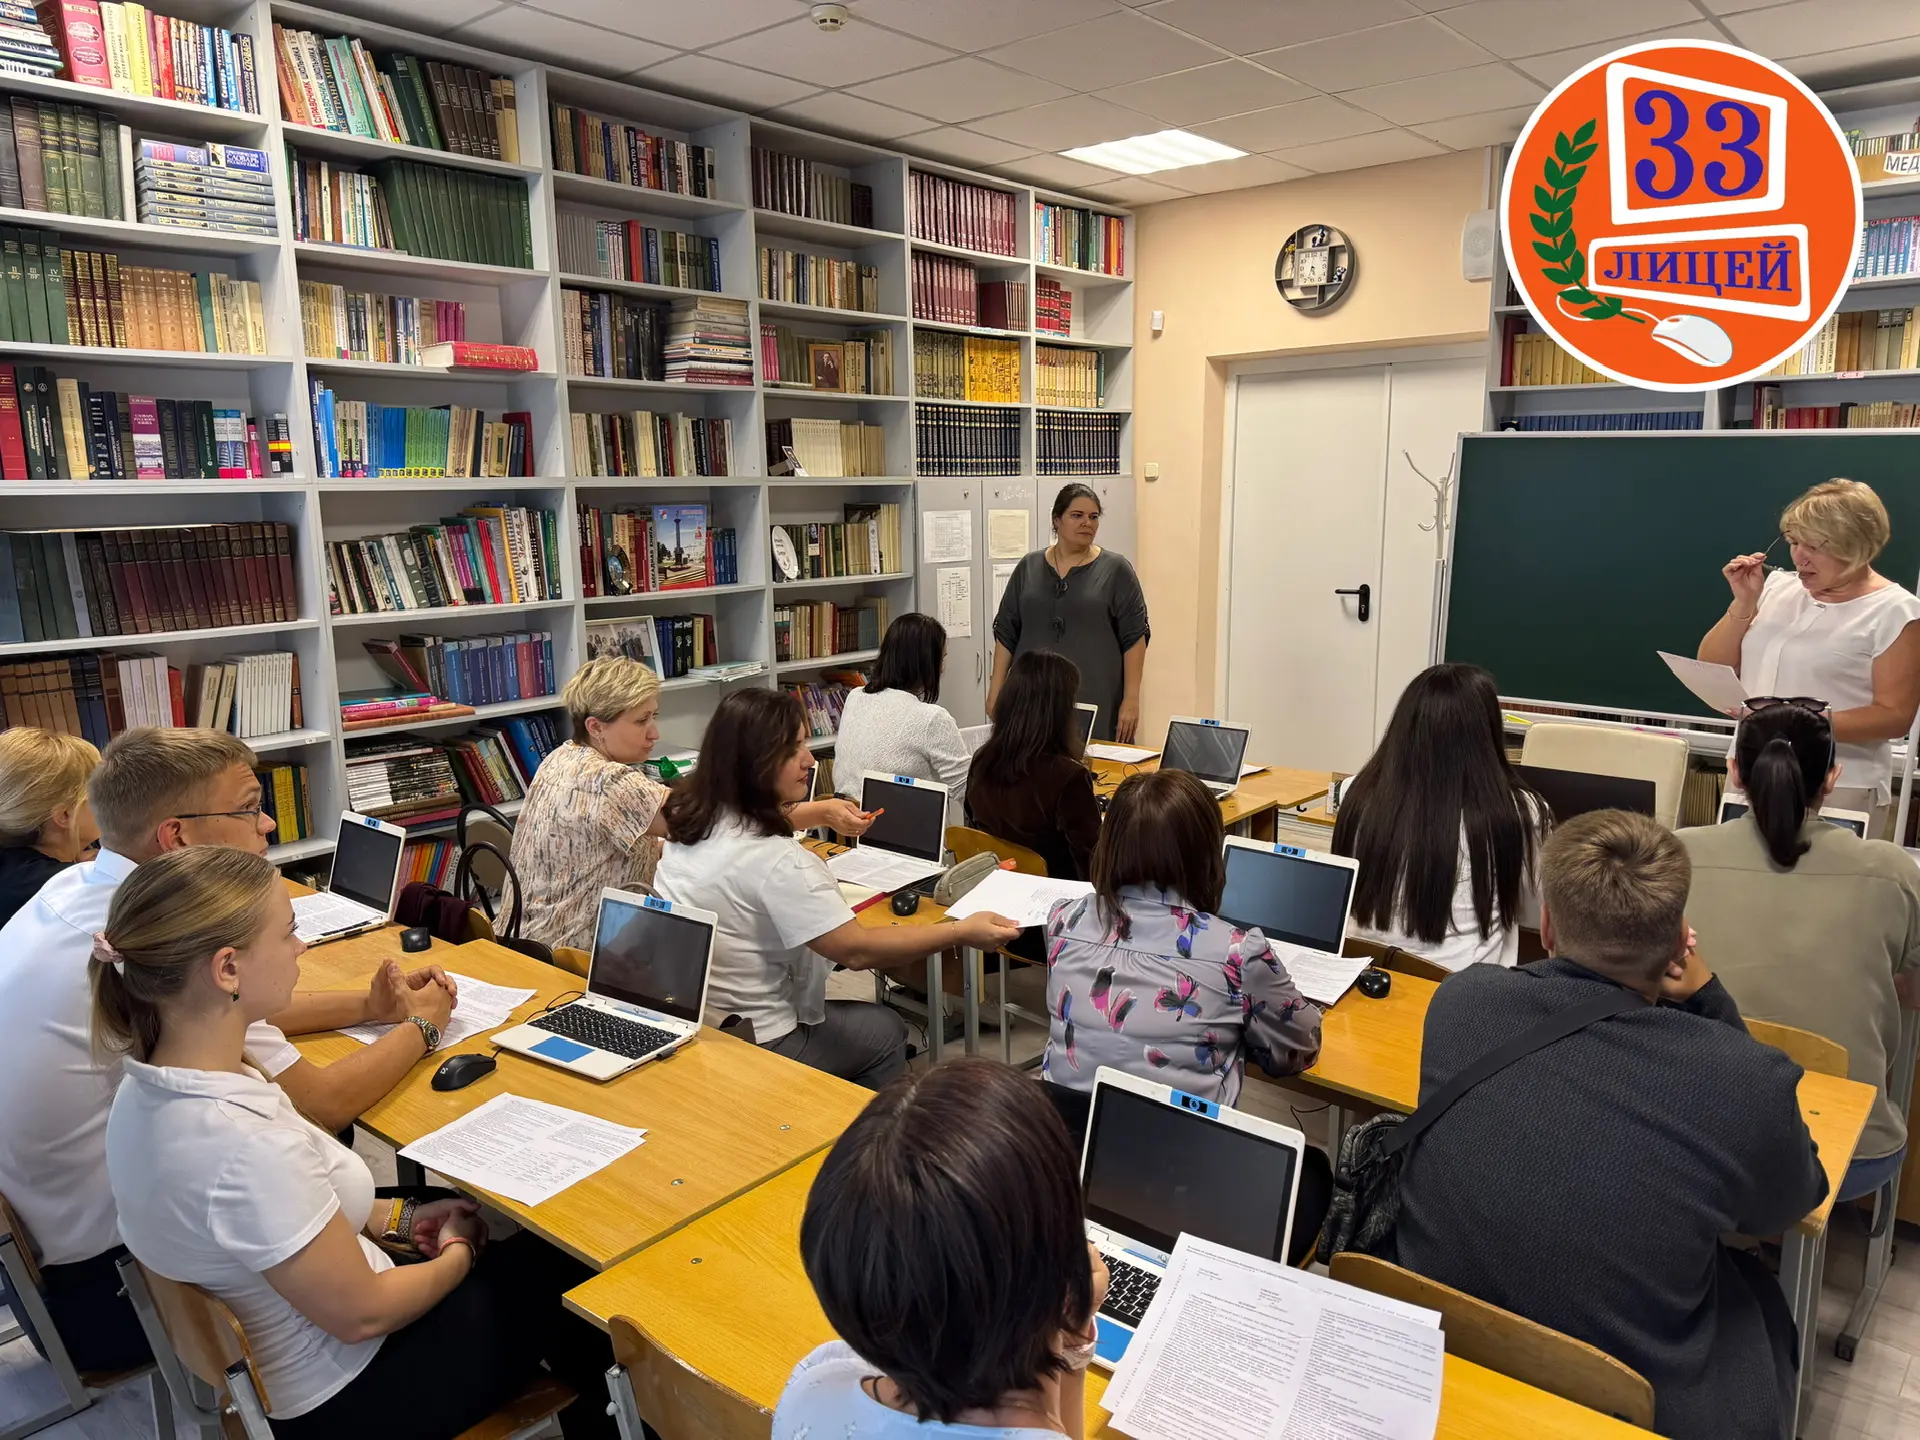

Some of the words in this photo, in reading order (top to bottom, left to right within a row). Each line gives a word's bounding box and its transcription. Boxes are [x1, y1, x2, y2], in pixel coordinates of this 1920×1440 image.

[291, 46, 309, 80] ШКОЛЬНИКА
[307, 46, 323, 80] ШКОЛЬНИКА
[321, 54, 336, 79] МИРА
[302, 80, 323, 124] СПРАВОЧНИК
[317, 82, 336, 125] СПРАВОЧНИК
[328, 81, 345, 116] СТРАНЫ
